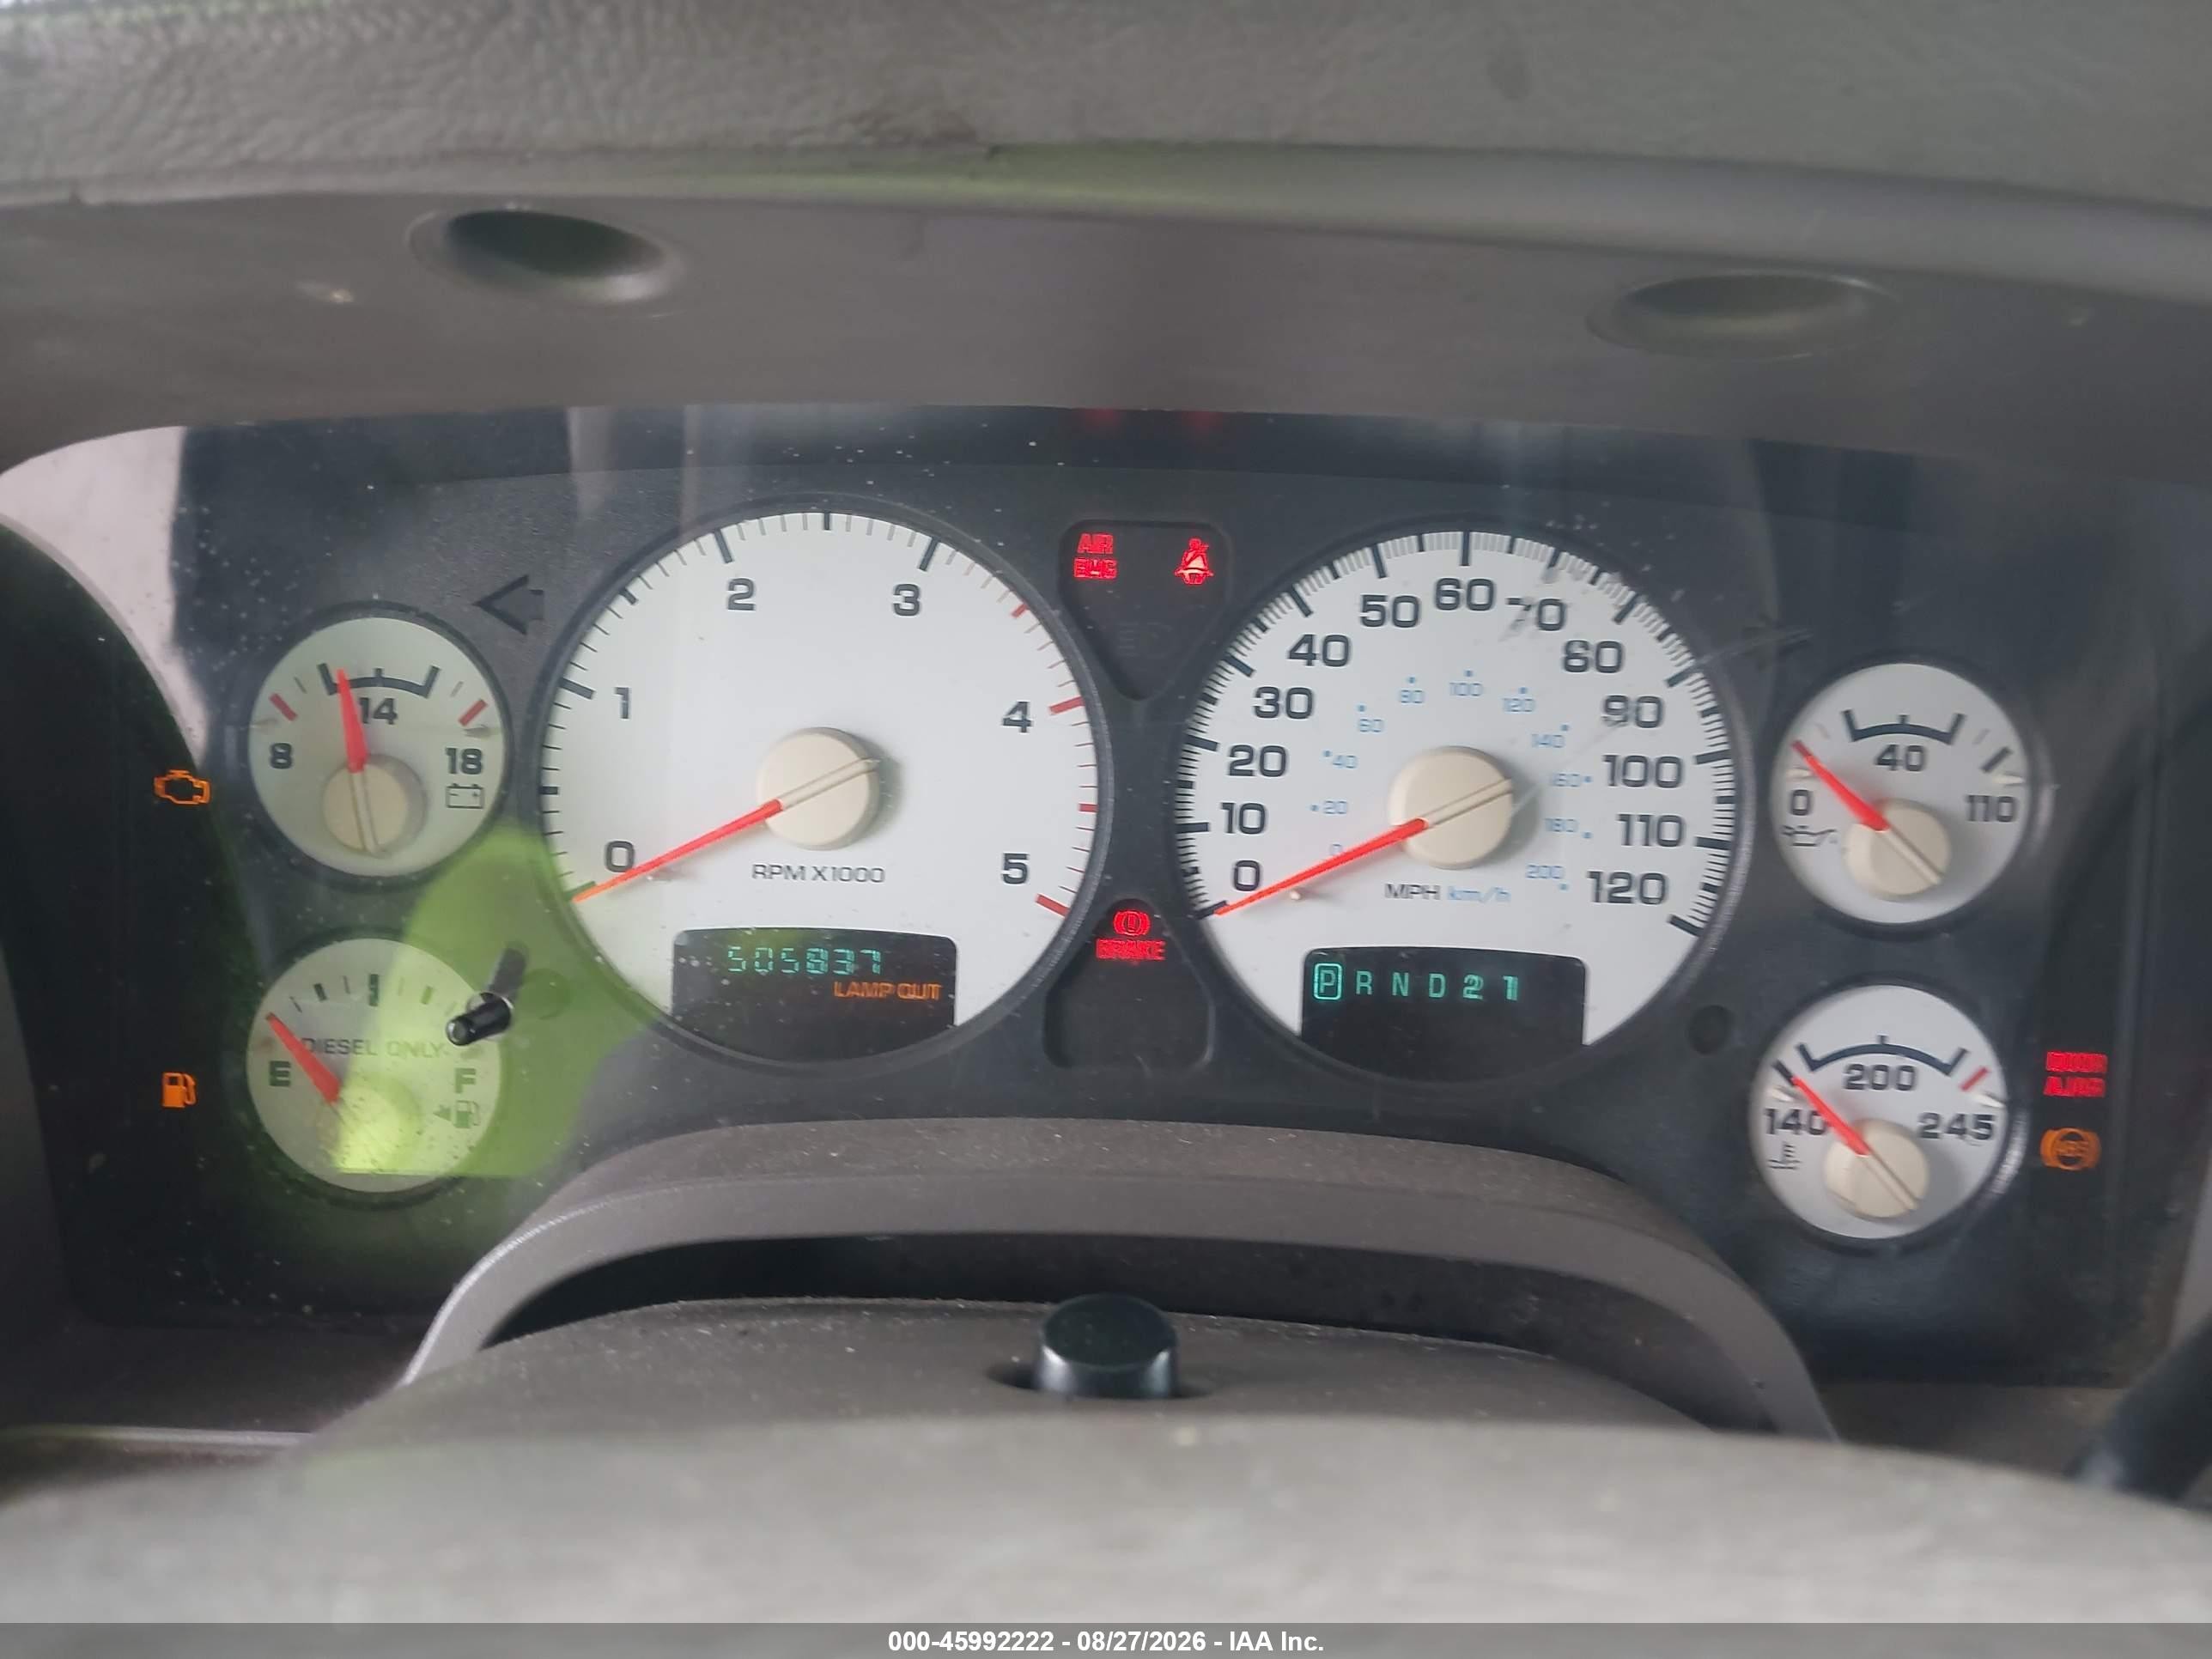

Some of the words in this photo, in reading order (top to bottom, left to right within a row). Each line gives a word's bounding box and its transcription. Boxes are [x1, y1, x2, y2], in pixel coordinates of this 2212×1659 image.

[727, 578, 755, 611] 2
[893, 584, 921, 616] 3
[1435, 578, 1495, 612] 60
[1359, 595, 1420, 628] 50
[1506, 597, 1566, 631] 70
[1288, 634, 1351, 667] 40
[1563, 640, 1623, 674] 80
[616, 687, 631, 720] 1
[1254, 686, 1315, 720] 30
[1449, 683, 1484, 697] 100
[359, 697, 398, 725] 14
[1002, 702, 1032, 733] 4
[1502, 698, 1535, 713] 120
[1602, 695, 1663, 729] 90
[270, 743, 293, 769] 8
[1531, 734, 1565, 749] 140
[445, 747, 483, 775] 18
[1228, 744, 1287, 778] 20
[1332, 755, 1358, 769] 40
[1603, 755, 1683, 788] 100
[1876, 744, 1926, 772] 40
[1324, 800, 1348, 815] 20
[1790, 788, 1811, 817] 0
[1966, 794, 2016, 823] 110
[1220, 803, 1267, 835] 10
[1619, 812, 1685, 847] 110
[605, 841, 635, 872] 0
[1003, 853, 1029, 884] 5
[752, 864, 805, 882] RPM
[811, 865, 884, 884] X1000
[1233, 860, 1261, 891] 0
[1526, 865, 1565, 879] 200
[1384, 883, 1441, 900] MPH
[1447, 885, 1511, 903] km/h
[1588, 871, 1668, 905] 120
[727, 946, 881, 974] 505837
[833, 981, 894, 998] LAMP
[896, 982, 941, 1000] OUT
[1356, 971, 1372, 994] R
[1392, 973, 1408, 996] N
[1429, 973, 1445, 998] D
[1462, 974, 1484, 1000] 2
[1503, 975, 1519, 1000] 1
[303, 1037, 378, 1055] DIESEL
[270, 1061, 291, 1086] E
[456, 1068, 477, 1094] F
[1844, 1063, 1918, 1091] 200
[1765, 1108, 1826, 1135] 140
[1918, 1112, 1994, 1140] 245
